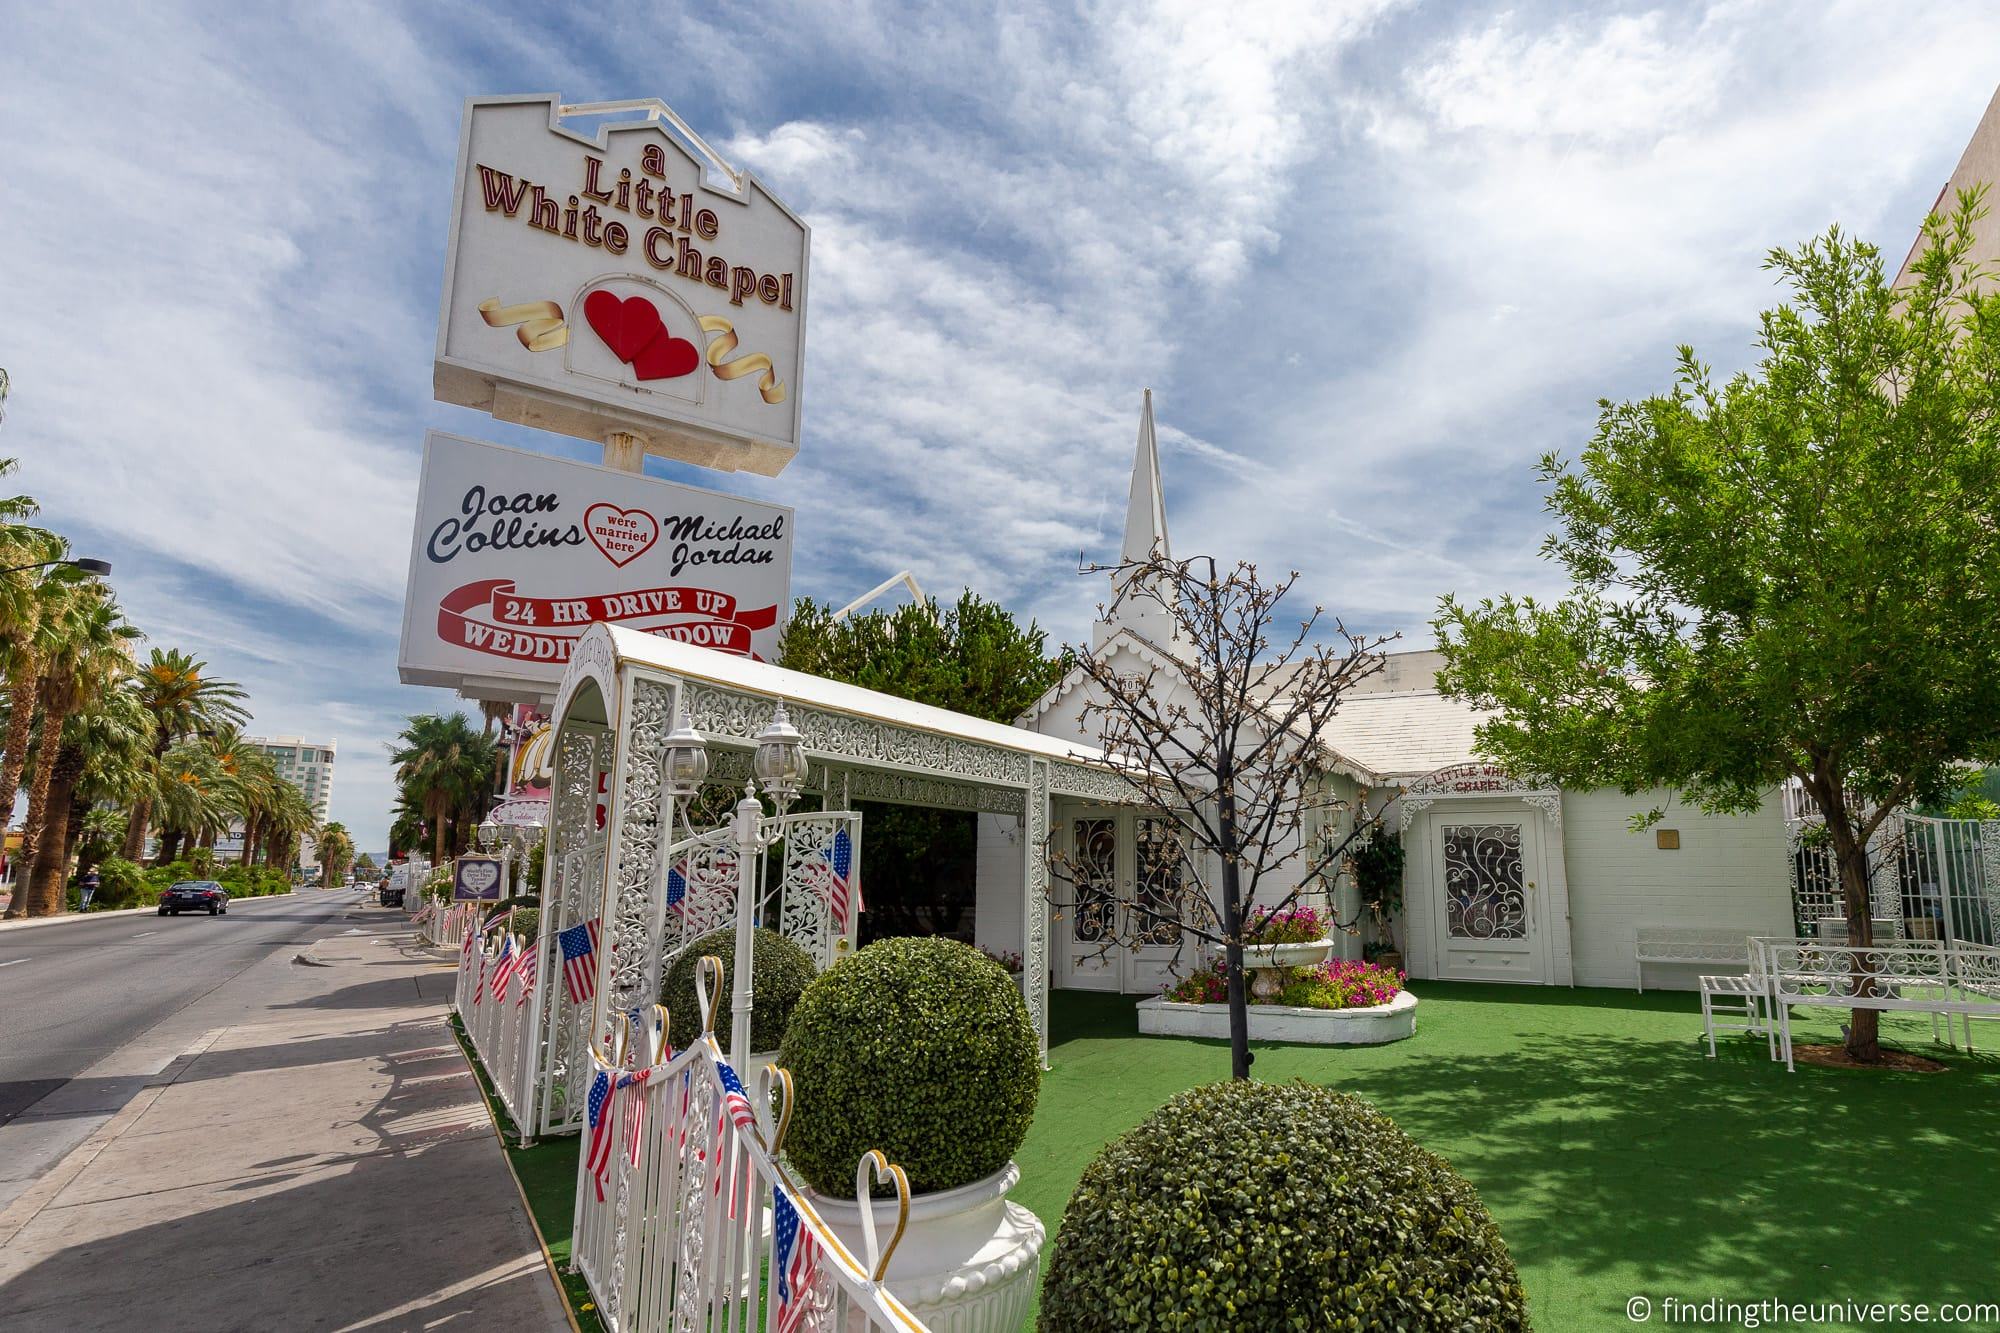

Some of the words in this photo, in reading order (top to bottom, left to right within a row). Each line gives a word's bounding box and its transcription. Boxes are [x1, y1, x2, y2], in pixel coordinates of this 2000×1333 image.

[641, 143, 667, 179] a
[582, 154, 719, 241] Little
[476, 162, 630, 255] White
[643, 225, 795, 312] Chapel
[461, 485, 560, 532] Joan
[607, 515, 637, 529] were
[427, 517, 586, 564] Collins
[595, 526, 648, 543] married
[606, 538, 635, 553] here
[663, 515, 784, 542] Michael
[670, 541, 774, 577] Jordan
[504, 600, 537, 625] 24
[551, 601, 593, 623] HR
[602, 590, 683, 618] DRIVE
[696, 591, 728, 614] UP
[464, 621, 580, 660] WEDDI
[1432, 766, 1478, 785] LITTLE
[1455, 779, 1504, 792] CHAPEL
